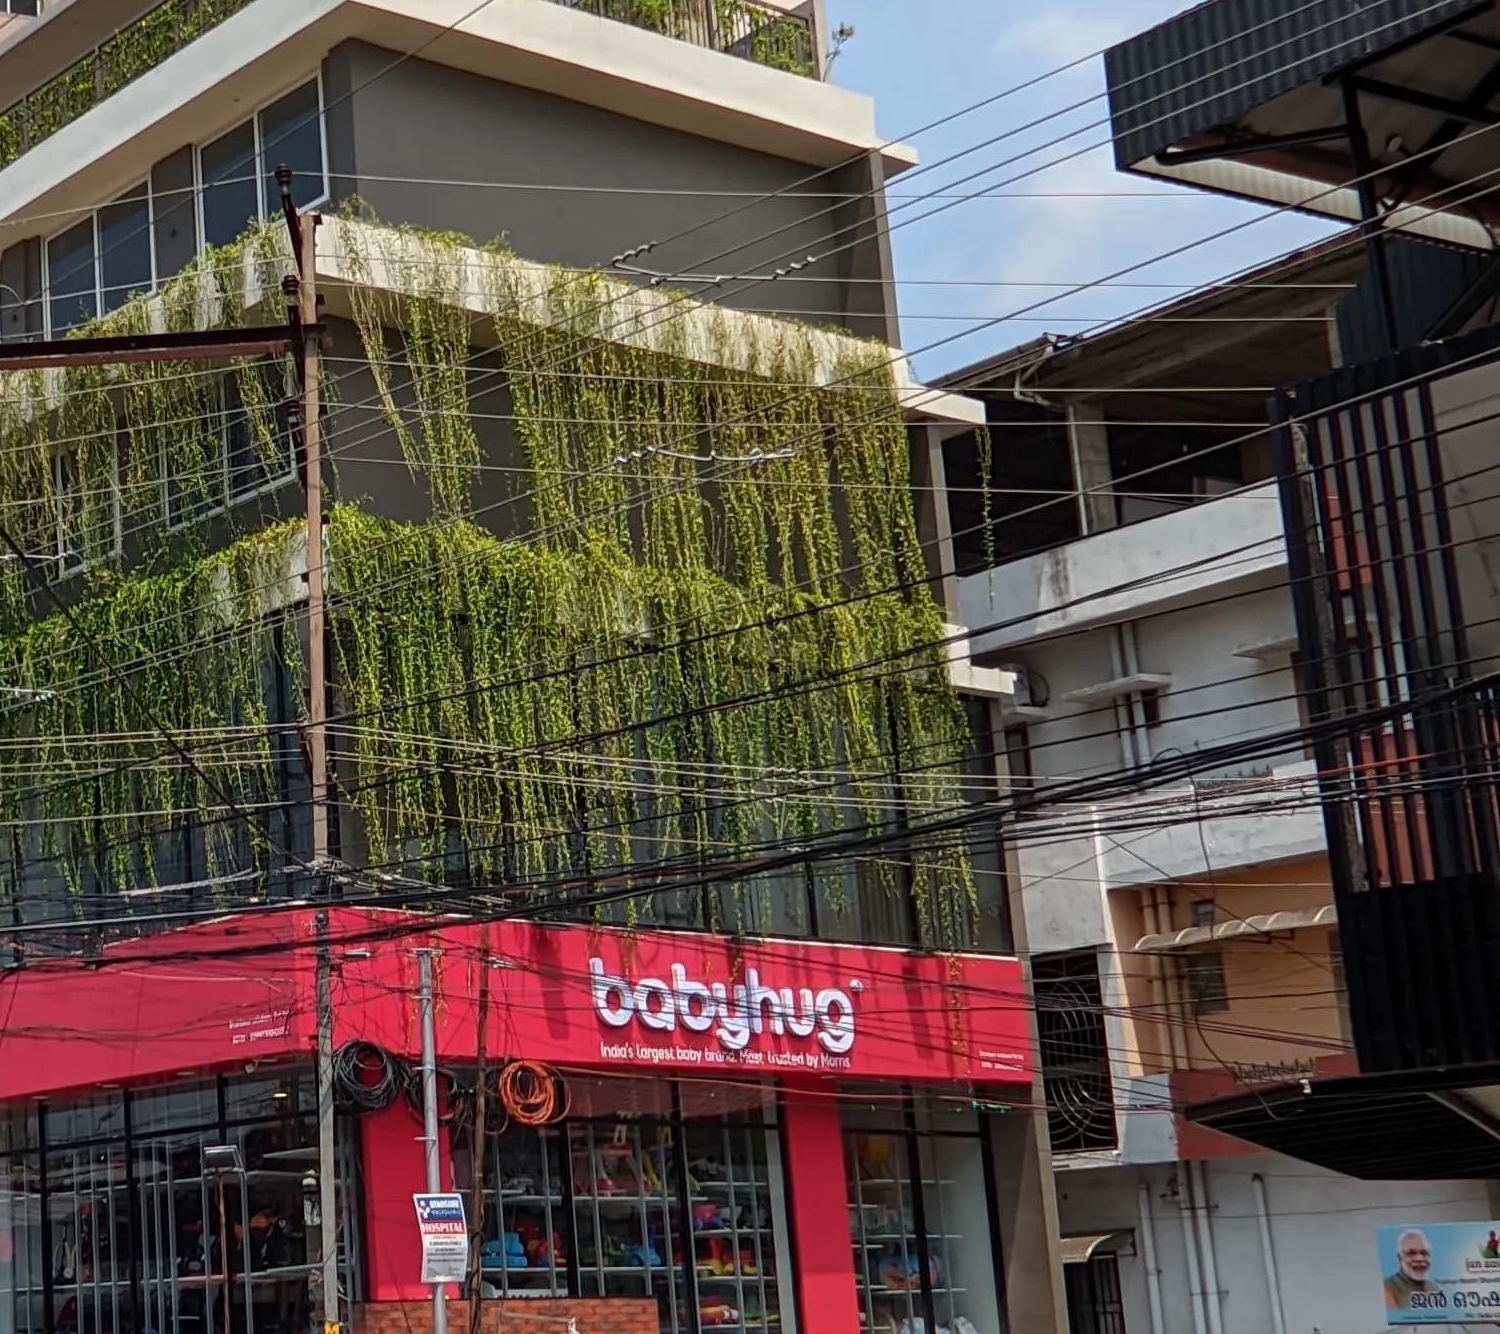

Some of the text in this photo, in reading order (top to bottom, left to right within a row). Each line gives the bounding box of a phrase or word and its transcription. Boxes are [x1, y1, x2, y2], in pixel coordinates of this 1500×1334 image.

[589, 957, 855, 1053] babyhug
[600, 1043, 633, 1059] India's
[636, 1044, 674, 1064] largest
[676, 1047, 702, 1064] baby
[806, 1053, 820, 1068] by
[821, 1055, 851, 1068] Moms
[420, 1222, 464, 1234] HOSPITAL
